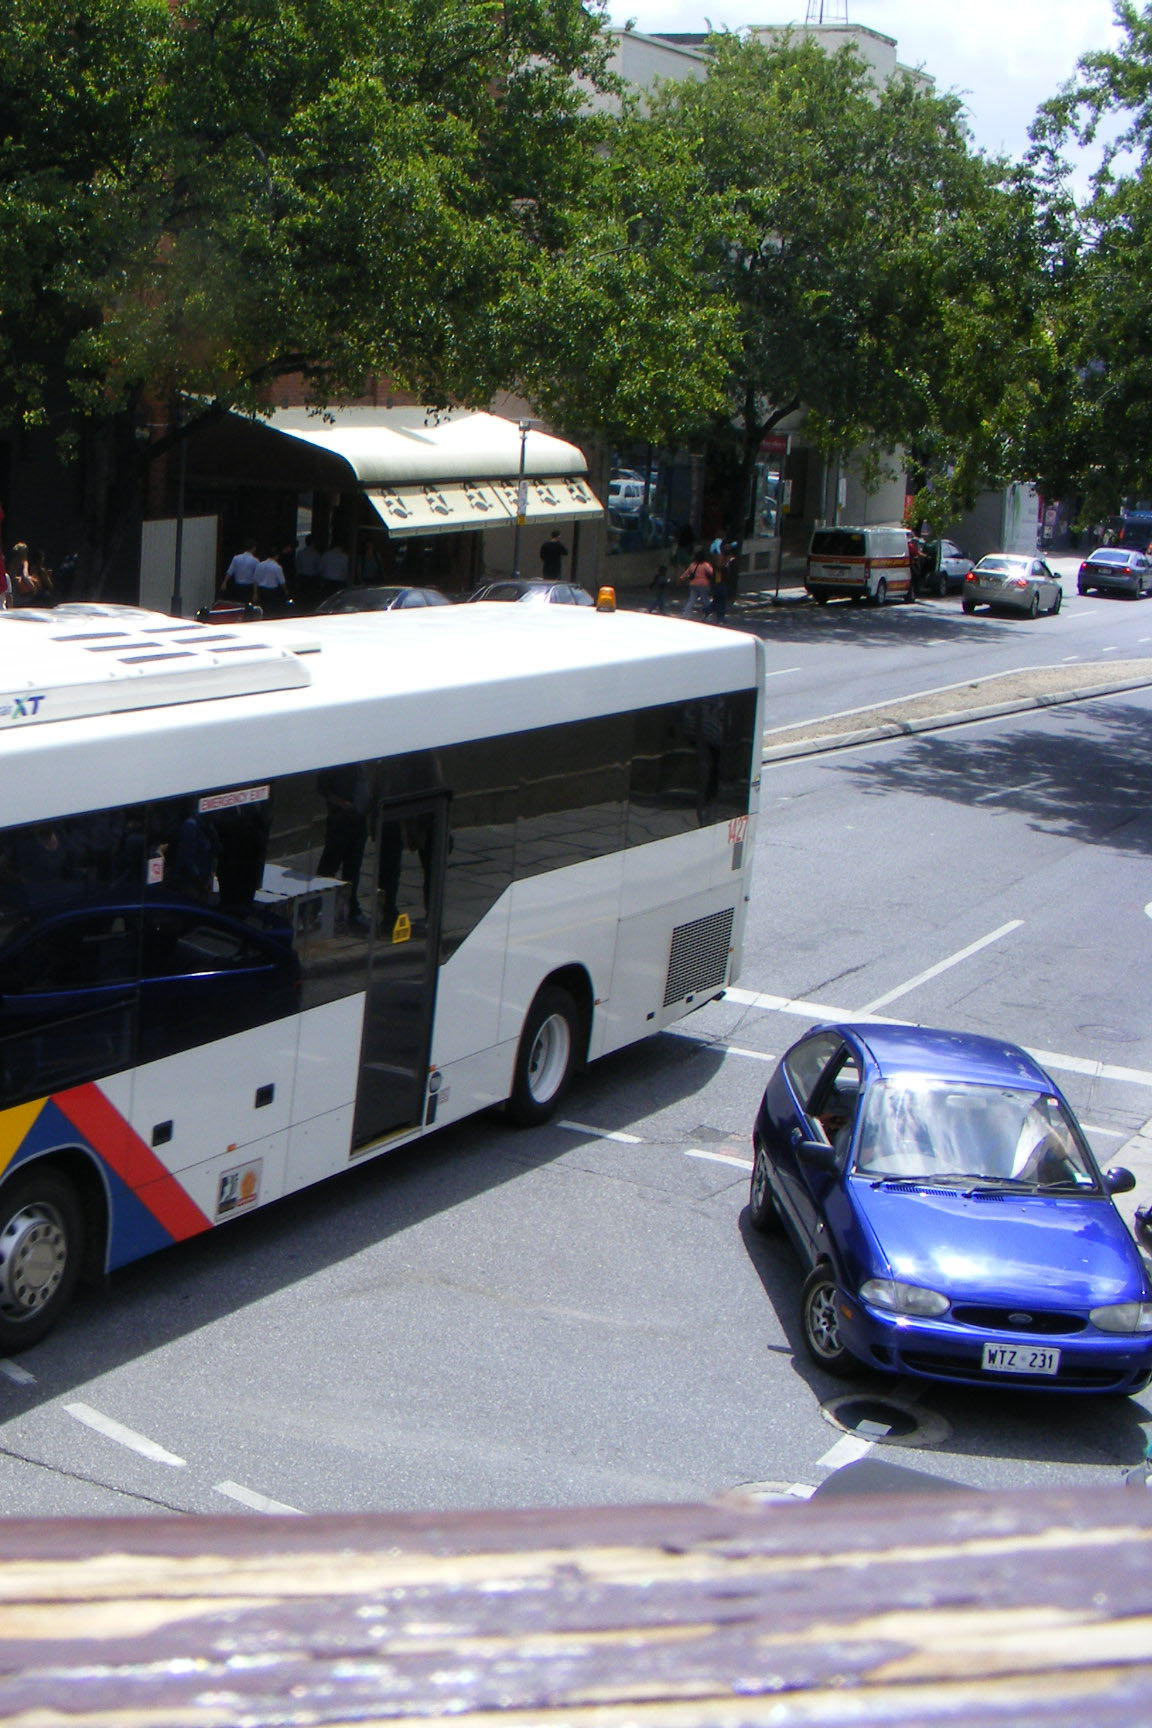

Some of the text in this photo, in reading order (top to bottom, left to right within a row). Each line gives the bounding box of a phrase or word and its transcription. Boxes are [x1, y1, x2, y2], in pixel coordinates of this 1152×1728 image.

[12, 695, 46, 719] XT
[988, 1349, 1053, 1369] WTZ 231
